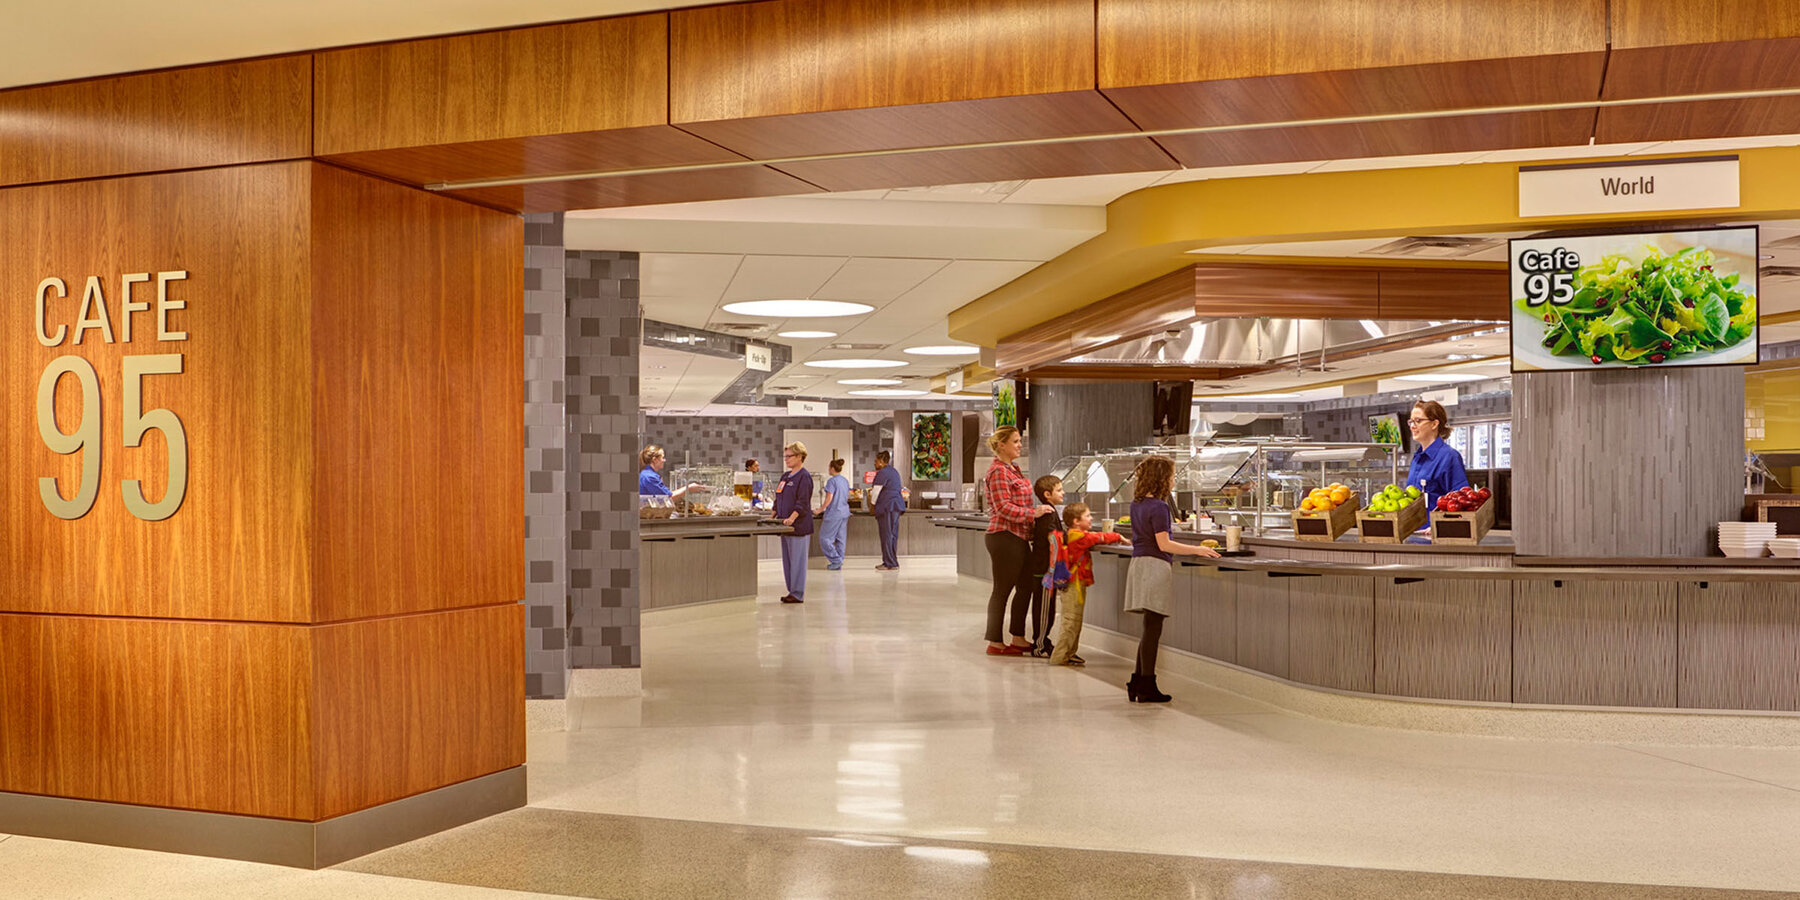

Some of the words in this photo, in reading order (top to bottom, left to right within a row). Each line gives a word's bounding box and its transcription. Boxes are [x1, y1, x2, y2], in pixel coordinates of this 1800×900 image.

[1600, 176, 1654, 196] World
[1519, 247, 1580, 273] Cafe
[1524, 273, 1575, 307] 95
[35, 270, 188, 347] CAFE
[36, 353, 189, 521] 95
